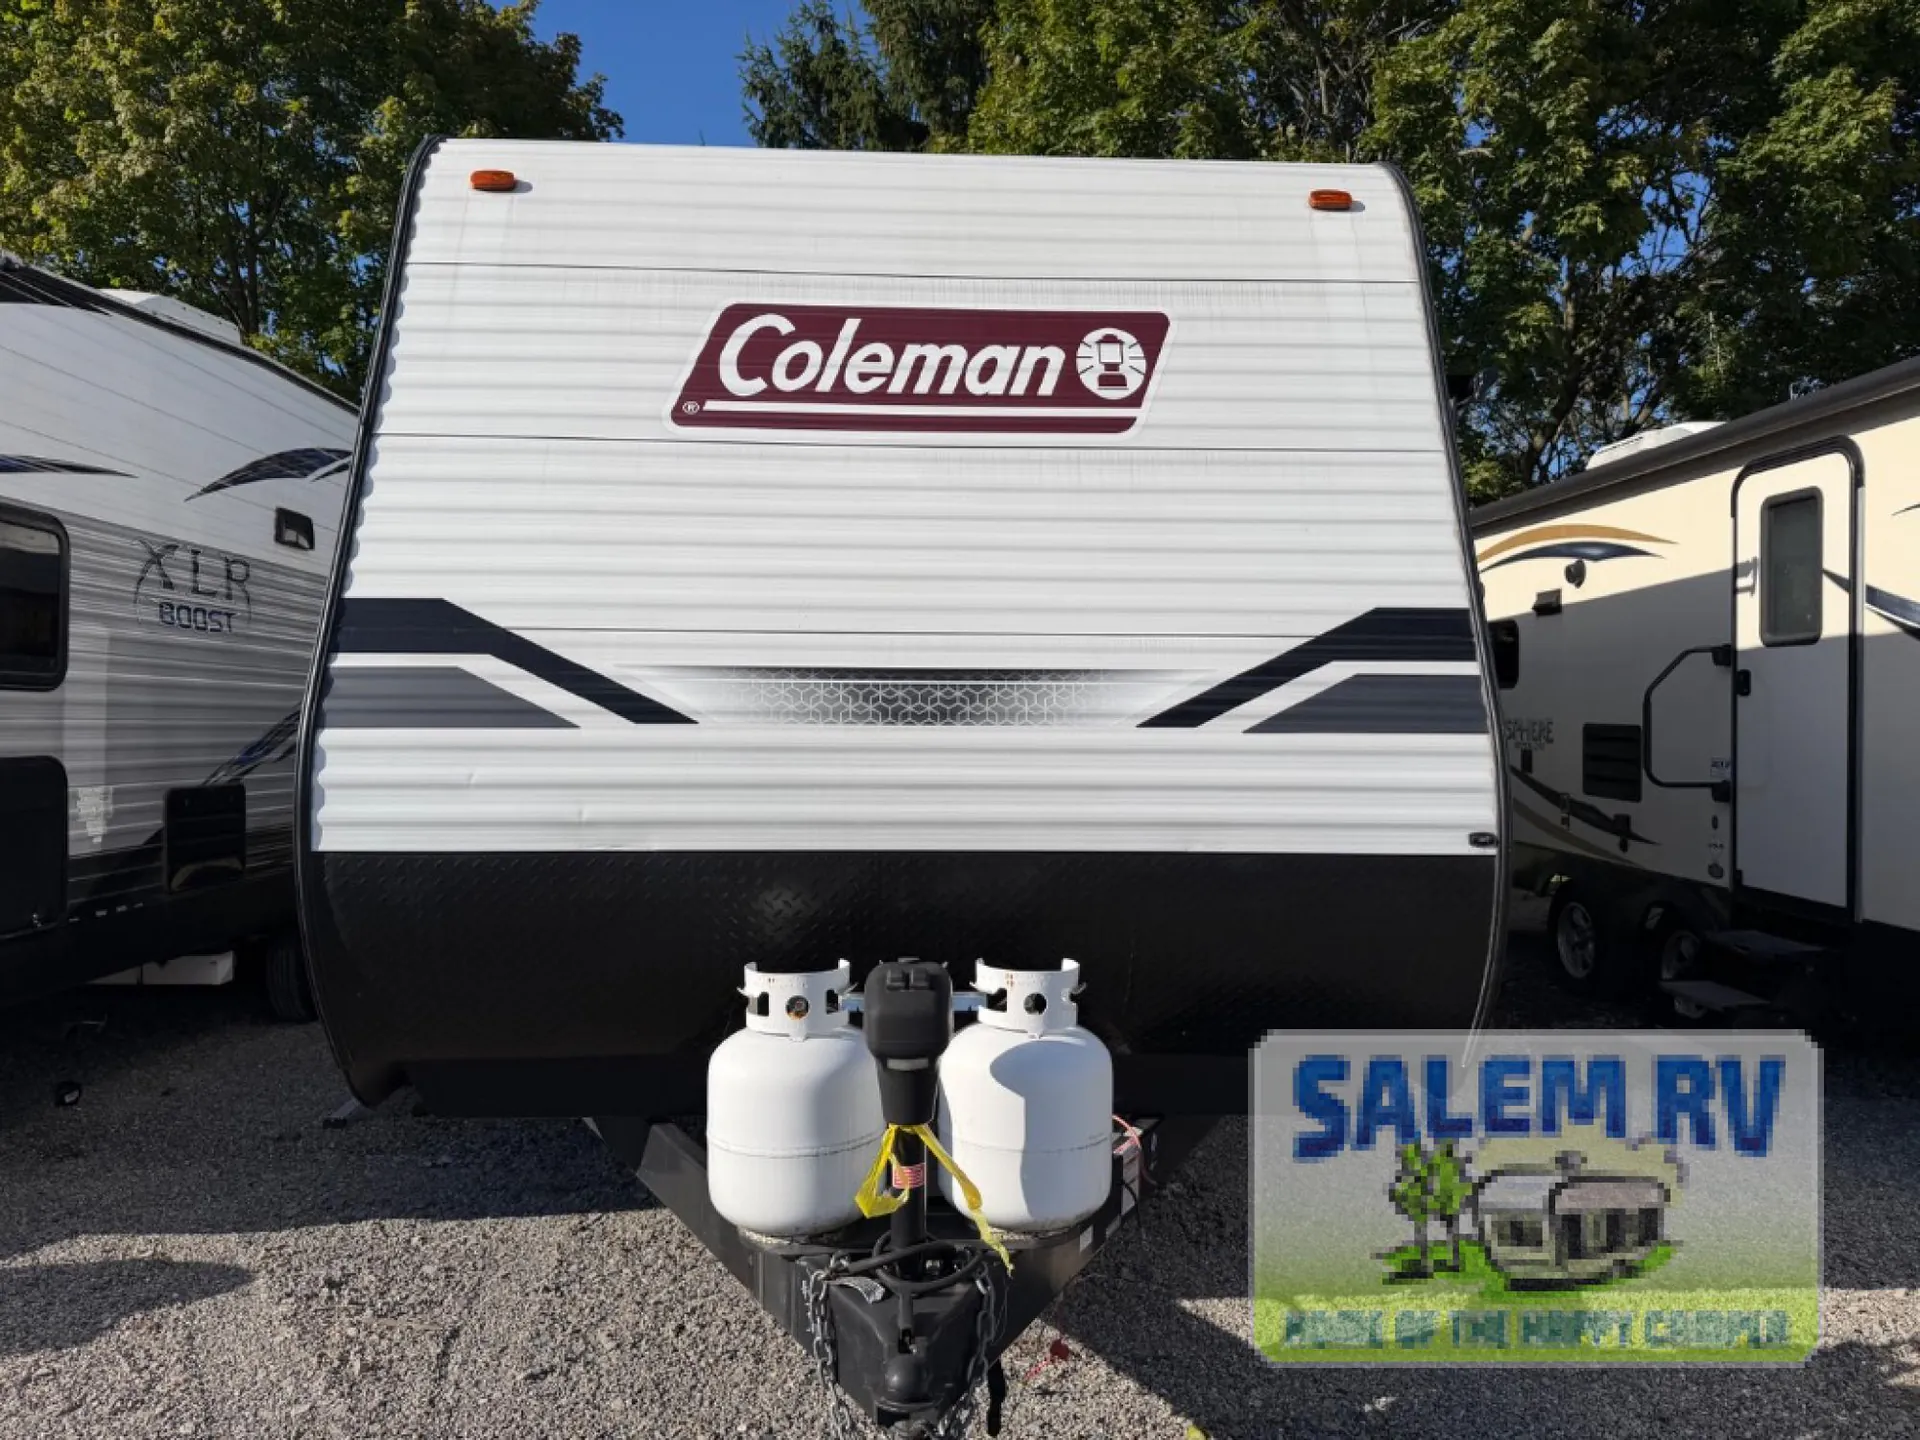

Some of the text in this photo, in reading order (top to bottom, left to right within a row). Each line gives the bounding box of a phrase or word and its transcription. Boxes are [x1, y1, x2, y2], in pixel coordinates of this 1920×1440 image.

[718, 312, 1067, 397] Coleman
[133, 538, 251, 606] XLR
[158, 601, 237, 633] BOOST
